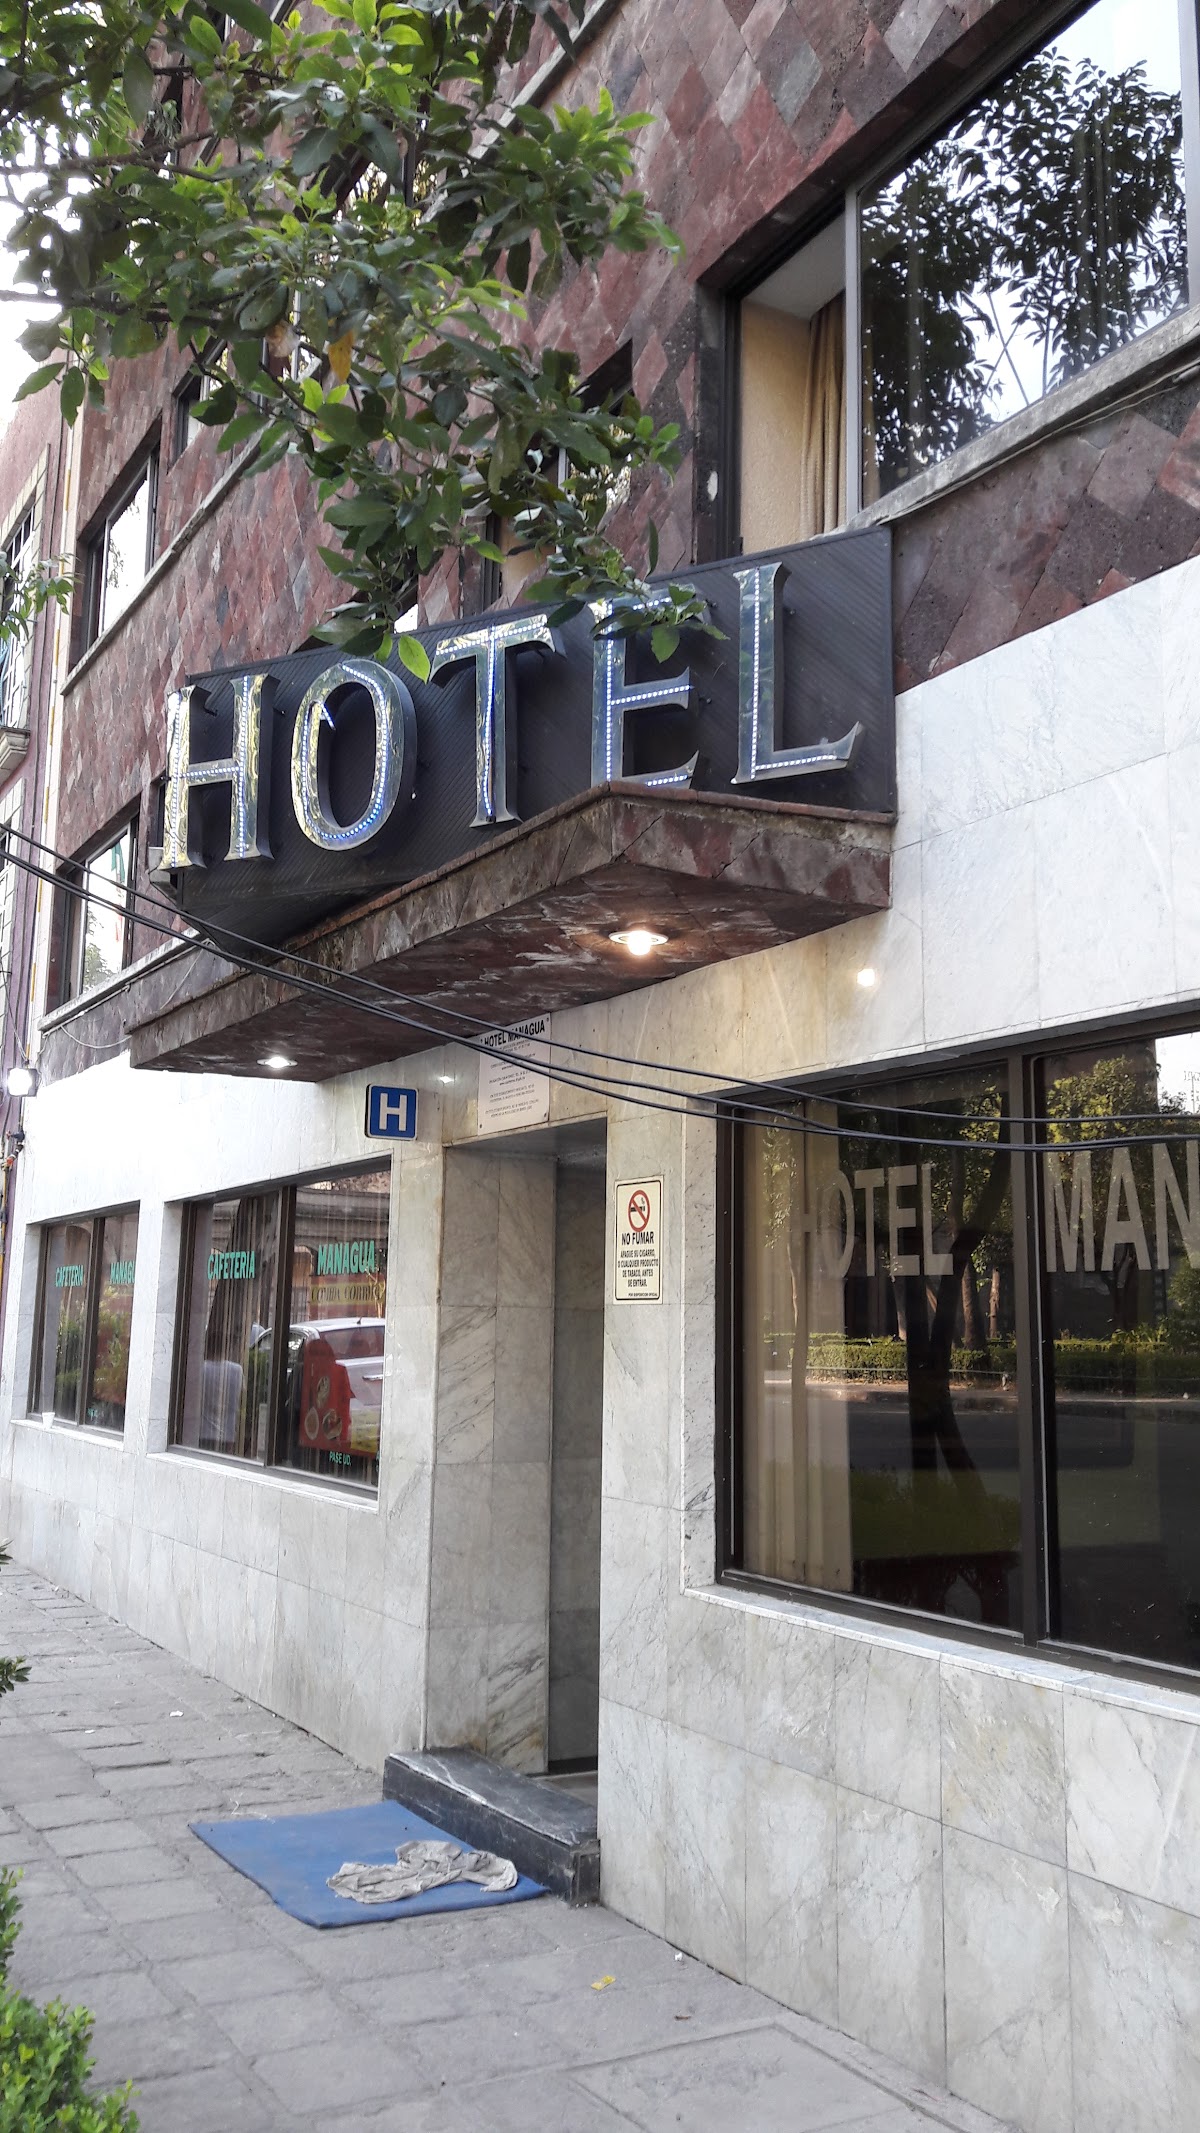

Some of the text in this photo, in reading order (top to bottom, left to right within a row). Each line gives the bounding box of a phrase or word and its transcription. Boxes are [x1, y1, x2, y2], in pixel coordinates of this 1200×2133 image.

[157, 561, 864, 871] HOTEL
[484, 1030, 507, 1047] HOTEL
[379, 1092, 408, 1132] H
[790, 1163, 954, 1281] HOTEL
[622, 1231, 655, 1245] NO FUMAR
[207, 1240, 375, 1280] CAFETERIA MANAGUA
[621, 1250, 633, 1258] APAGUE
[634, 1249, 639, 1258] SU
[621, 1259, 640, 1268] CUALQUIER
[640, 1258, 659, 1268] PRODUCTO
[55, 1264, 84, 1287] CAFETERIA
[642, 1269, 653, 1277] ANTES
[628, 1279, 633, 1287] DE
[329, 1451, 342, 1464] PASE
